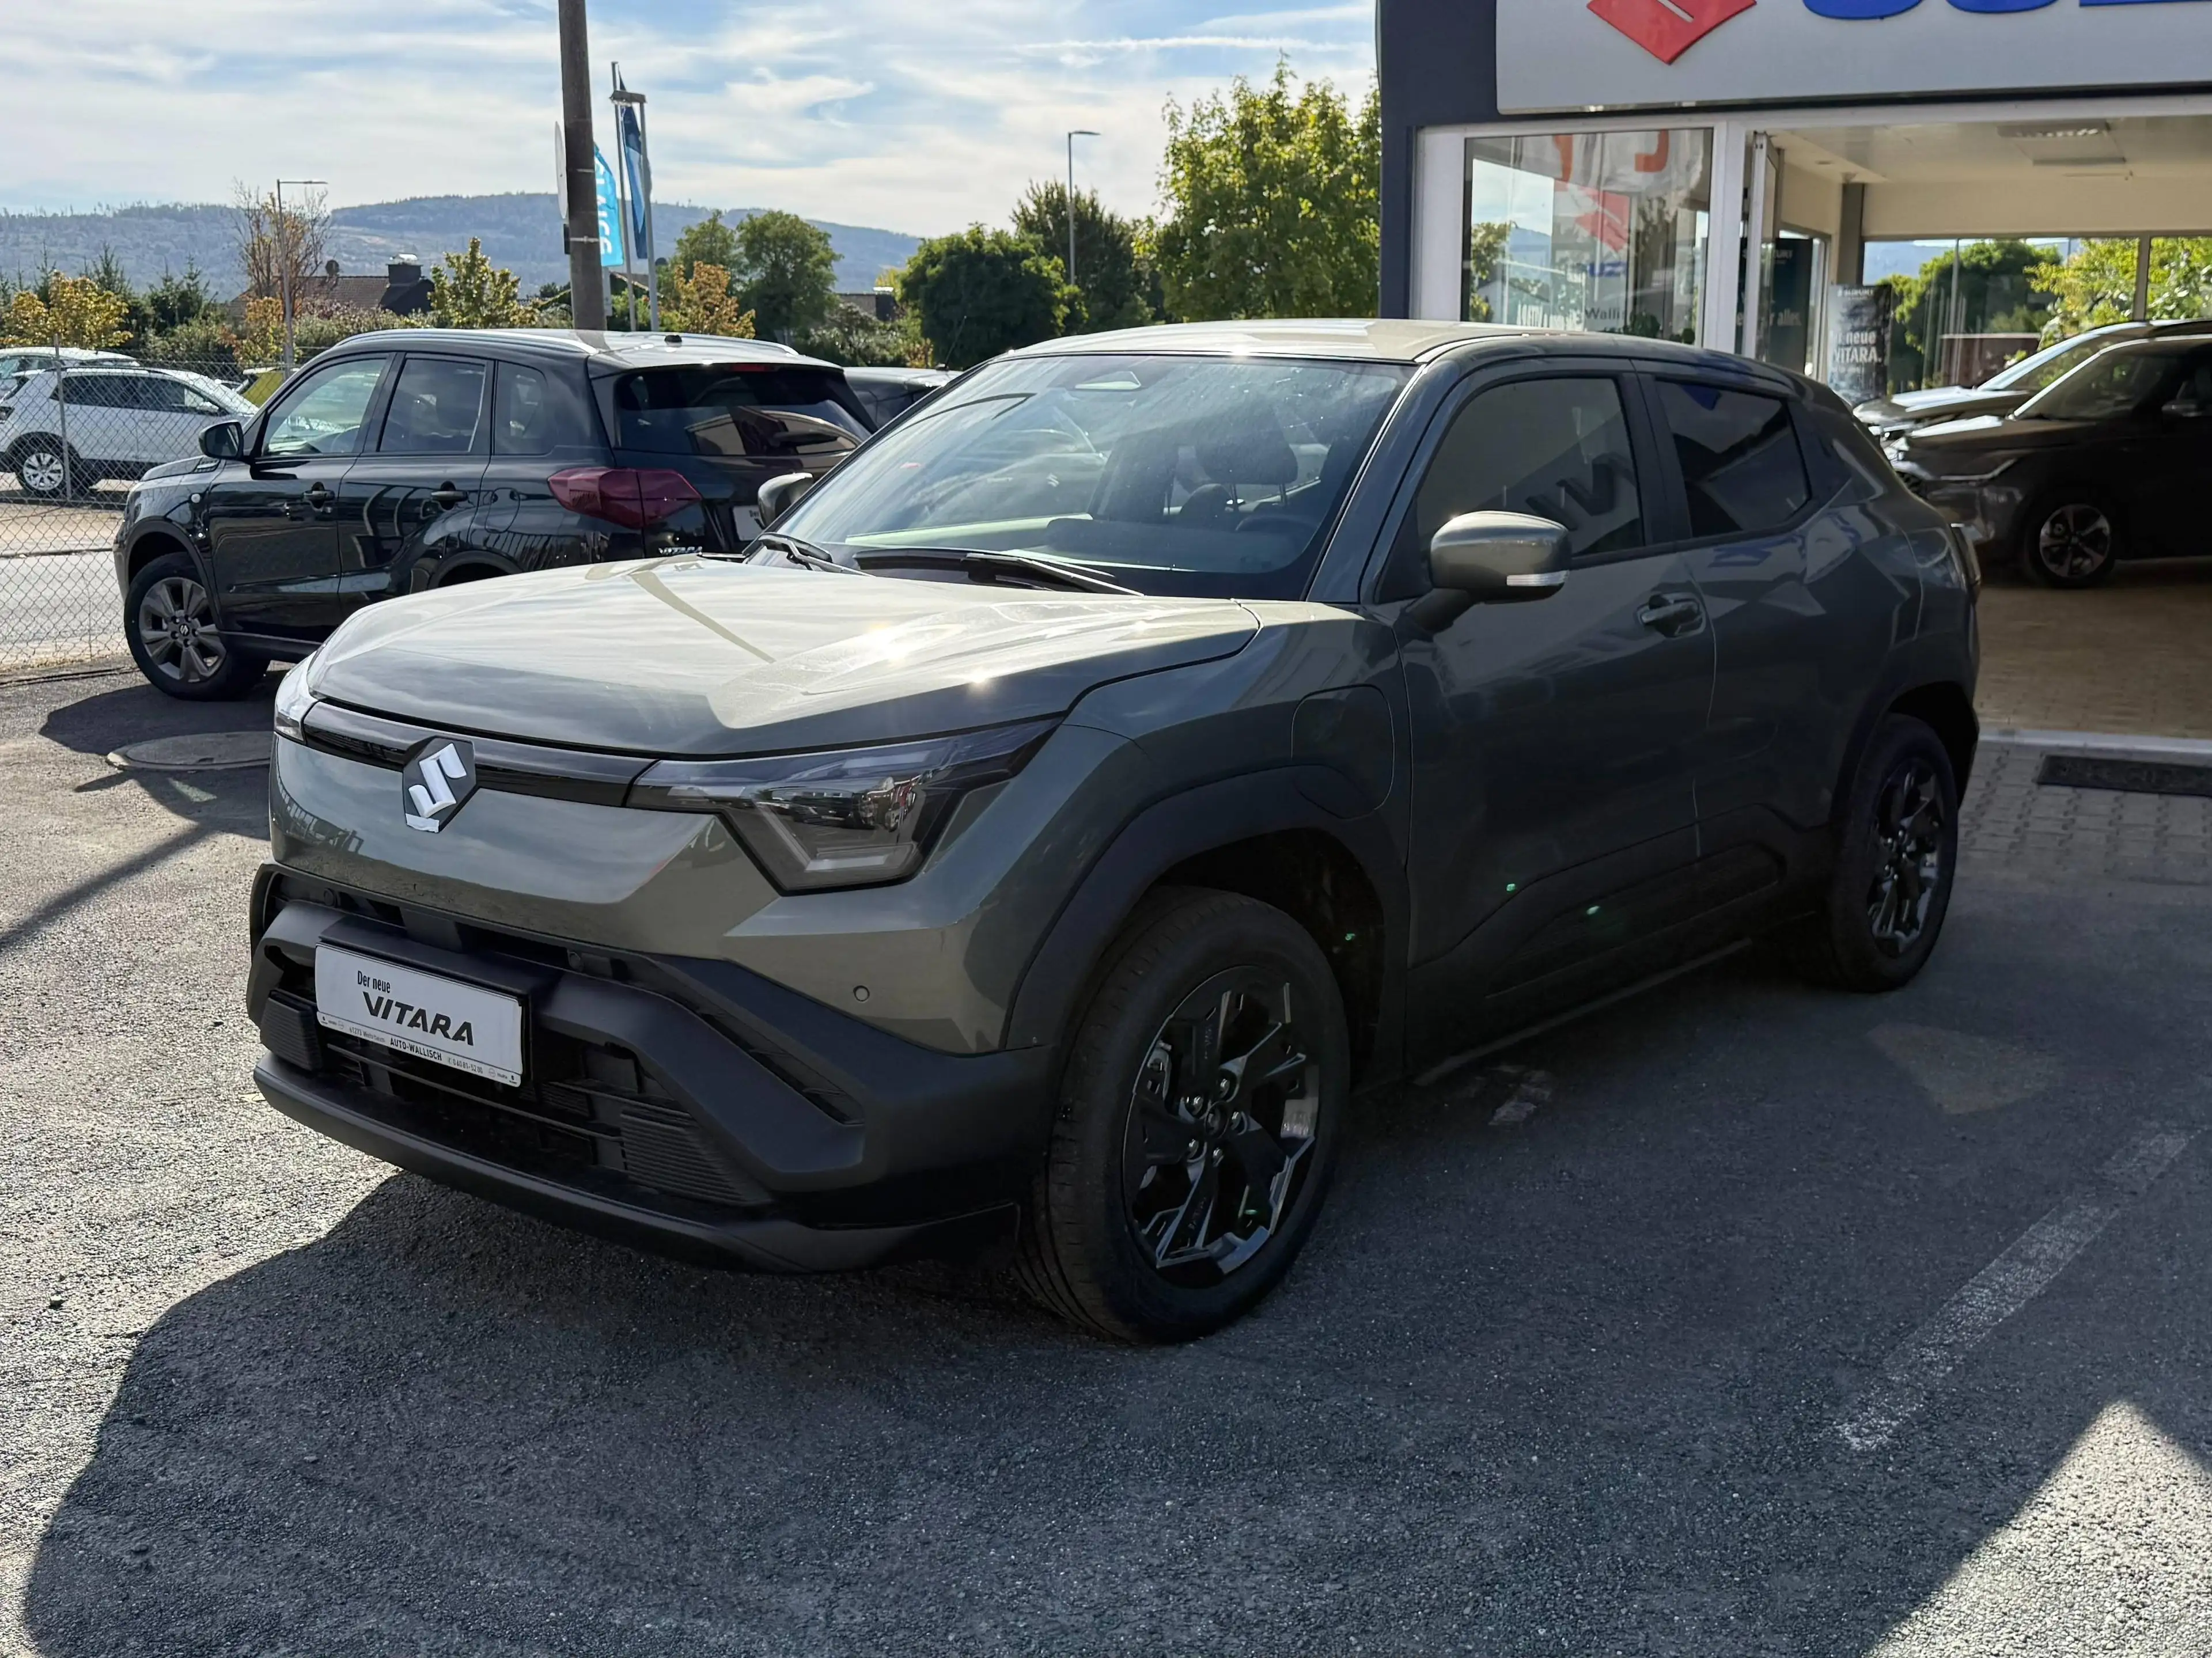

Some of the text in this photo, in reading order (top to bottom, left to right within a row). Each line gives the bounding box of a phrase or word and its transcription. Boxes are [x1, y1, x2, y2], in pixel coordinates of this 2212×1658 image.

[1846, 331, 1876, 345] neue
[1834, 347, 1882, 364] VITARA.
[357, 970, 391, 993] Der neue
[362, 991, 474, 1046] VITARA
[390, 1037, 442, 1061] AUTO-WALLISCH
